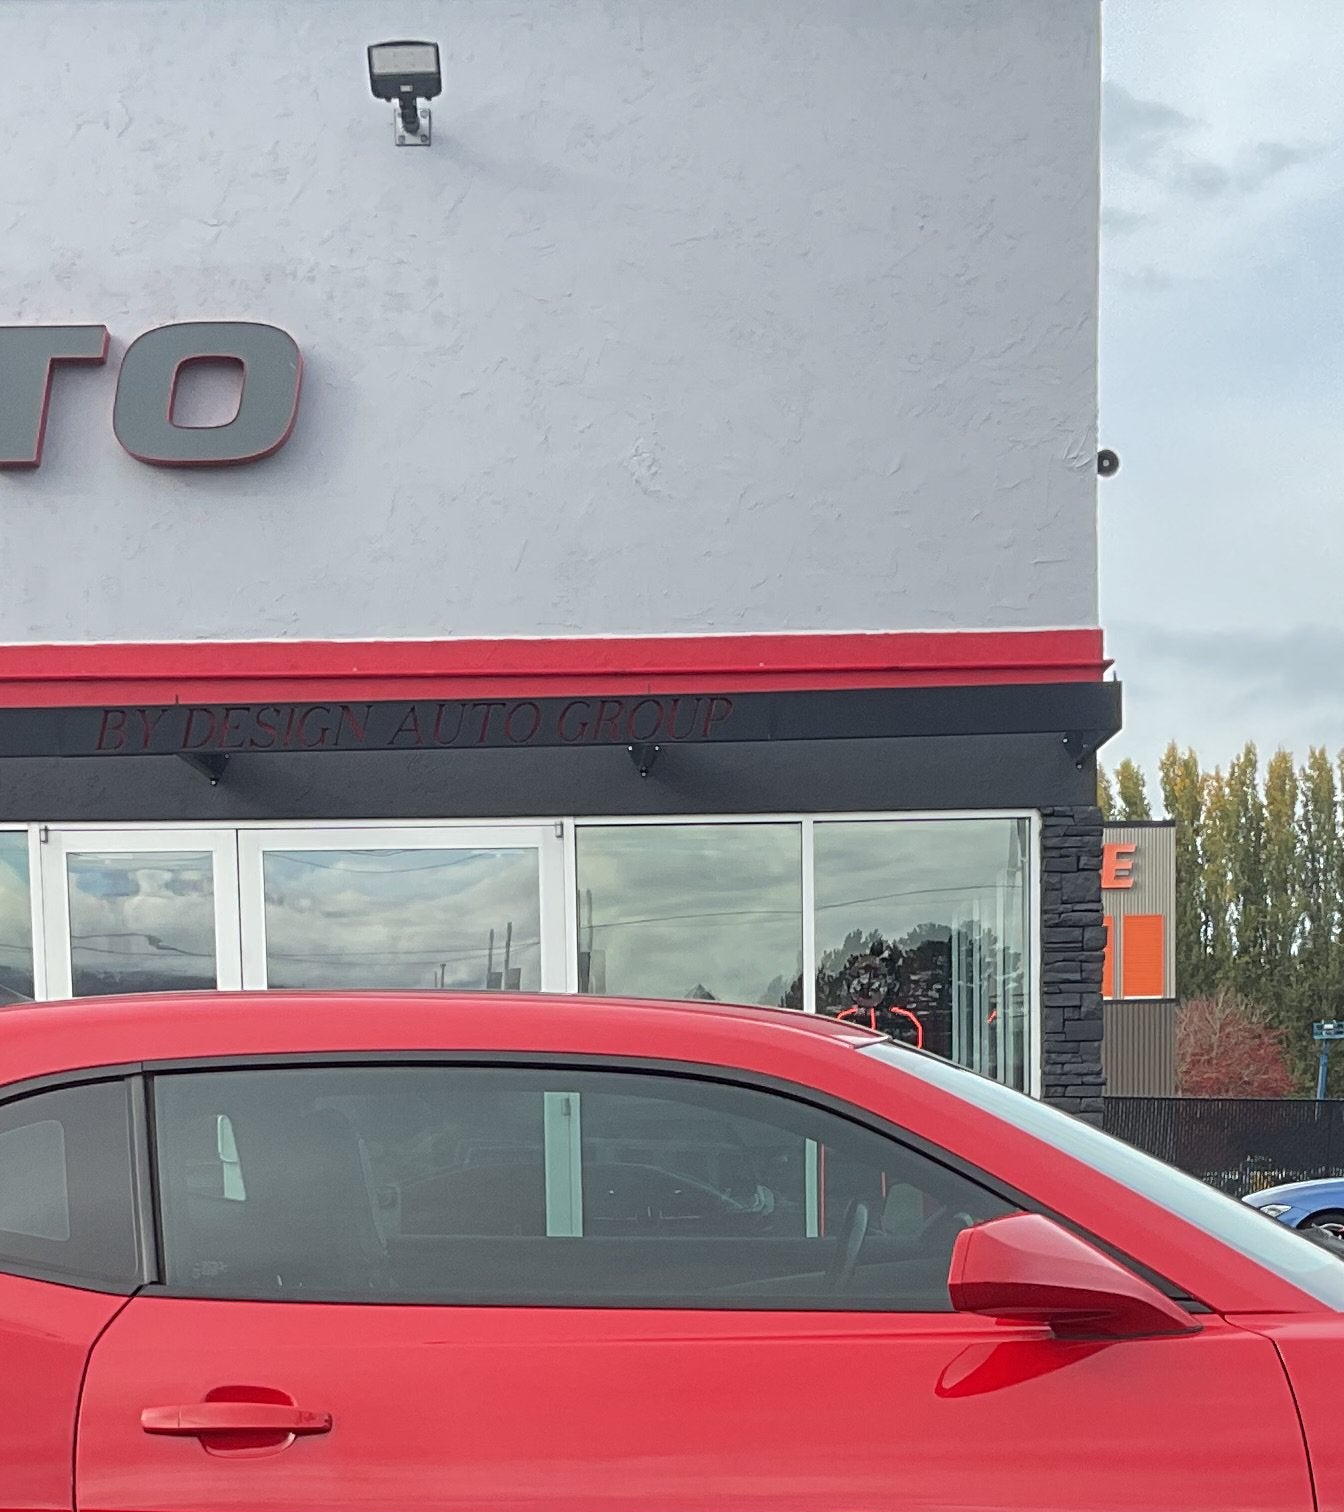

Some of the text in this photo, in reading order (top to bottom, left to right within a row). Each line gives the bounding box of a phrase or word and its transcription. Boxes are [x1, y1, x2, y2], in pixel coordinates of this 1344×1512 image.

[96, 697, 735, 750] BY DESIGN AUTO GROUP
